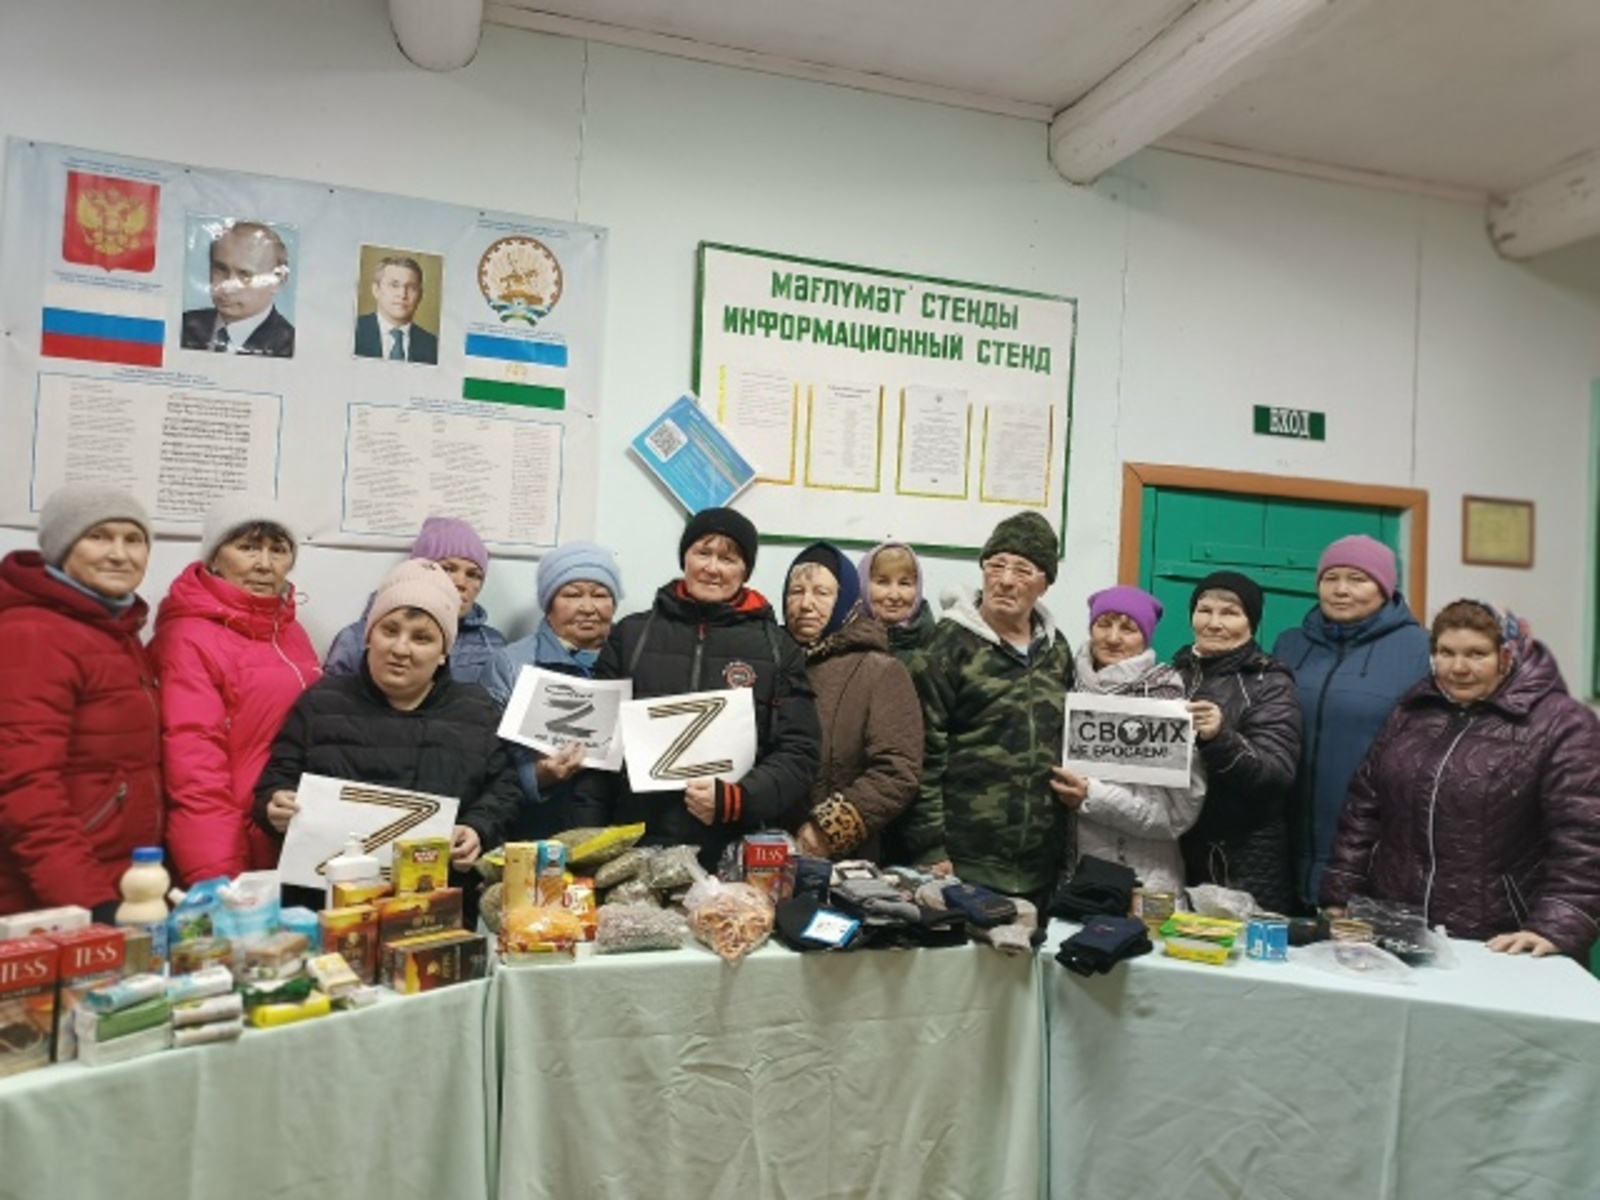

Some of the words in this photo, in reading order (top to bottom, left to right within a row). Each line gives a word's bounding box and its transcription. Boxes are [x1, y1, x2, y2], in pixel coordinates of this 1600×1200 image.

[922, 292, 1018, 330] СТЕНДЫ
[723, 304, 963, 361] ИНФОРМАЦИОННЫЙ
[976, 339, 1051, 375] СТЕНД
[648, 696, 733, 780] Z
[1078, 717, 1188, 746] СВОИХ
[0, 956, 49, 984] TESS
[74, 942, 119, 970] TESS
